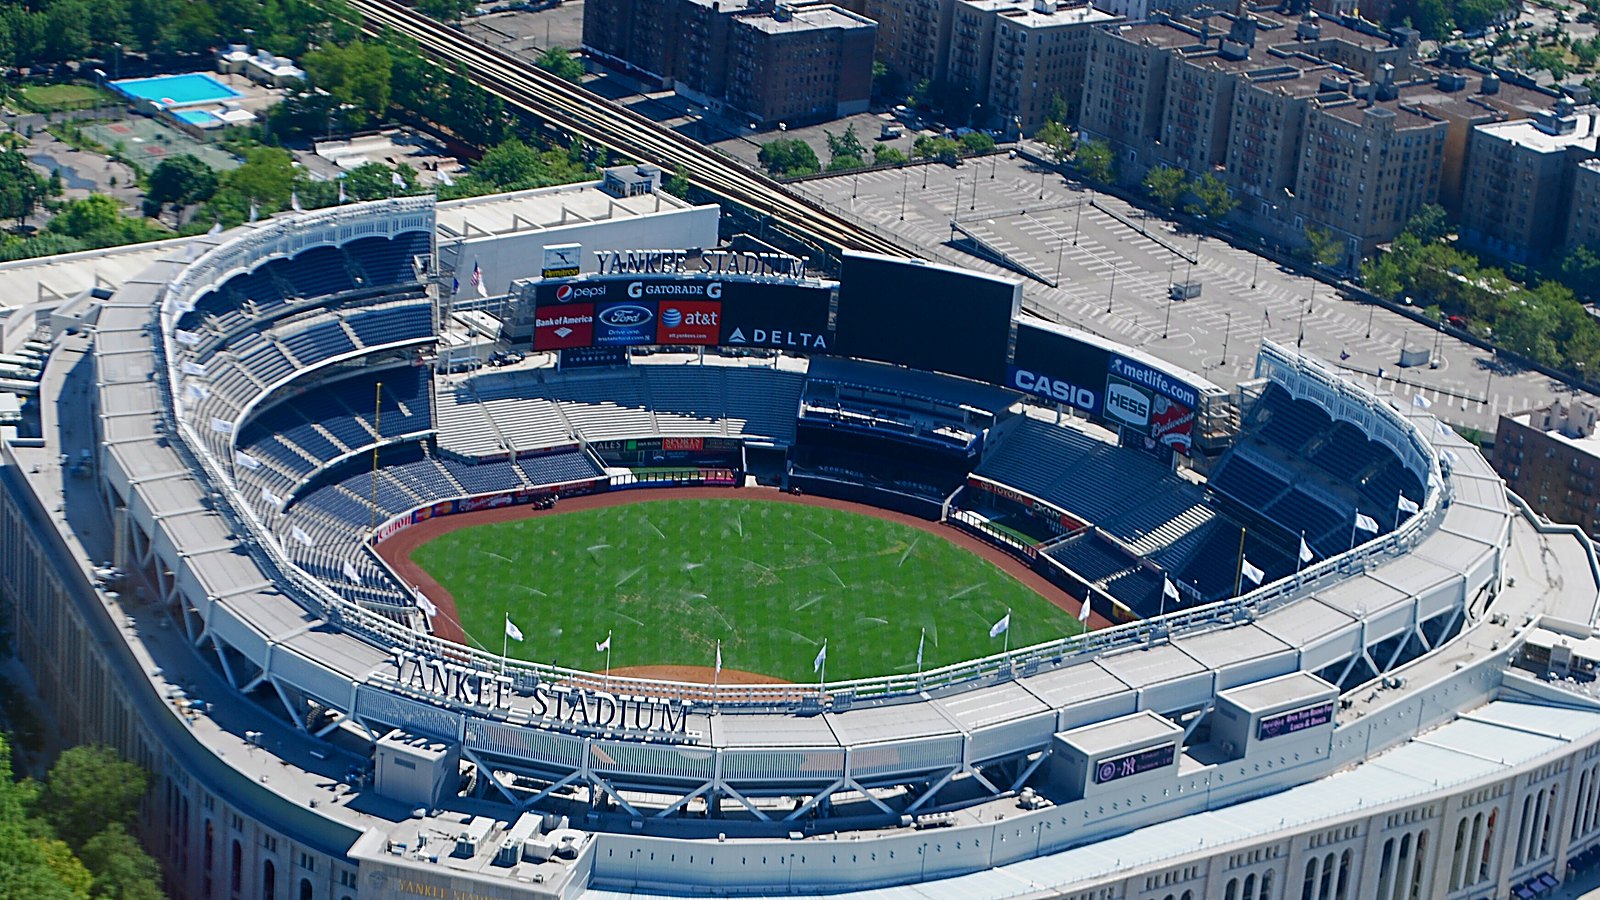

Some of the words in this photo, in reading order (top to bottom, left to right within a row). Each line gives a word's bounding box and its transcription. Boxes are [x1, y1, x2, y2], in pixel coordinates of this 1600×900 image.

[592, 249, 688, 275] YANKEE
[699, 250, 810, 280] STADIUM
[573, 285, 607, 298] pepsi
[627, 281, 643, 298] G
[645, 285, 704, 295] GATORADE
[706, 282, 722, 299] G
[535, 318, 554, 327] Bank
[554, 316, 563, 326] of
[562, 315, 593, 325] America
[610, 309, 641, 323] Ford
[684, 310, 718, 326] at&t
[753, 329, 827, 349] DELTA
[1015, 369, 1095, 410] CASIO
[1123, 362, 1195, 406] metlife.com
[1108, 390, 1147, 419] HESS
[1151, 411, 1196, 438] Budweiser
[664, 437, 702, 445] SPORTS
[993, 485, 1024, 502] TOYOTA
[377, 515, 412, 539] Canon
[390, 647, 515, 710] YANKEE
[530, 682, 693, 735] STADIUM
[399, 879, 446, 899] YANKEE
